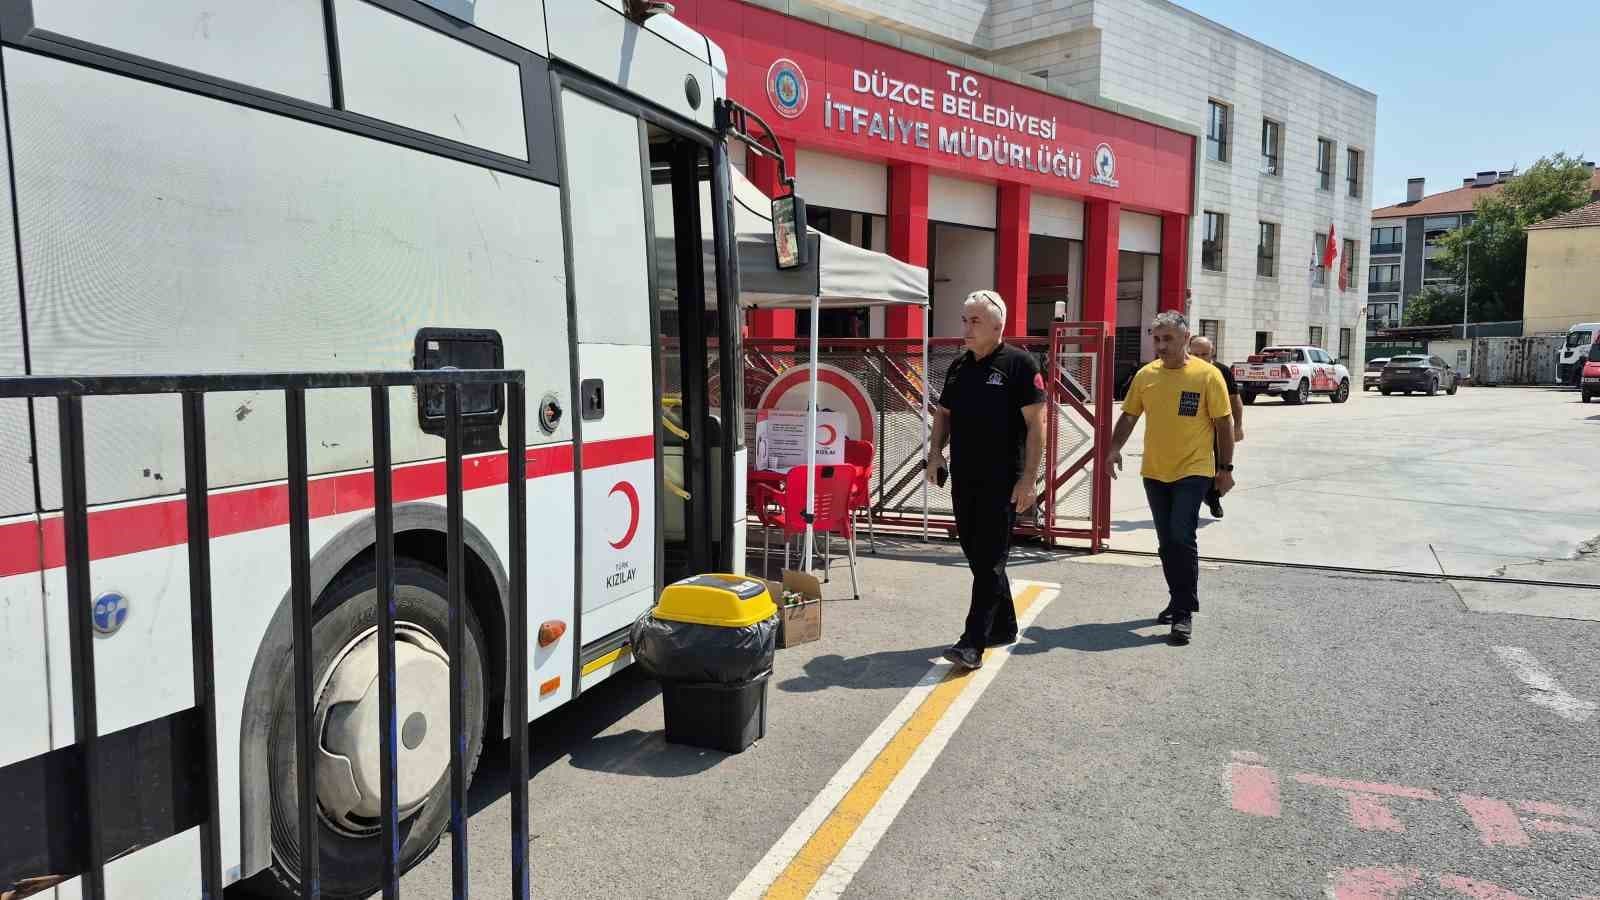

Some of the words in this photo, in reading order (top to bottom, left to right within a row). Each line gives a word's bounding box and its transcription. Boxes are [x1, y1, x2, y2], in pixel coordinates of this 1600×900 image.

[853, 69, 935, 110] DÜZCE
[942, 93, 1056, 140] BELEDİYESİ
[946, 70, 982, 98] T.C.
[824, 92, 929, 149] İTFAİYE
[938, 126, 1082, 181] MÜDÜRLÜĞÜ
[606, 567, 637, 589] KIZILAY
